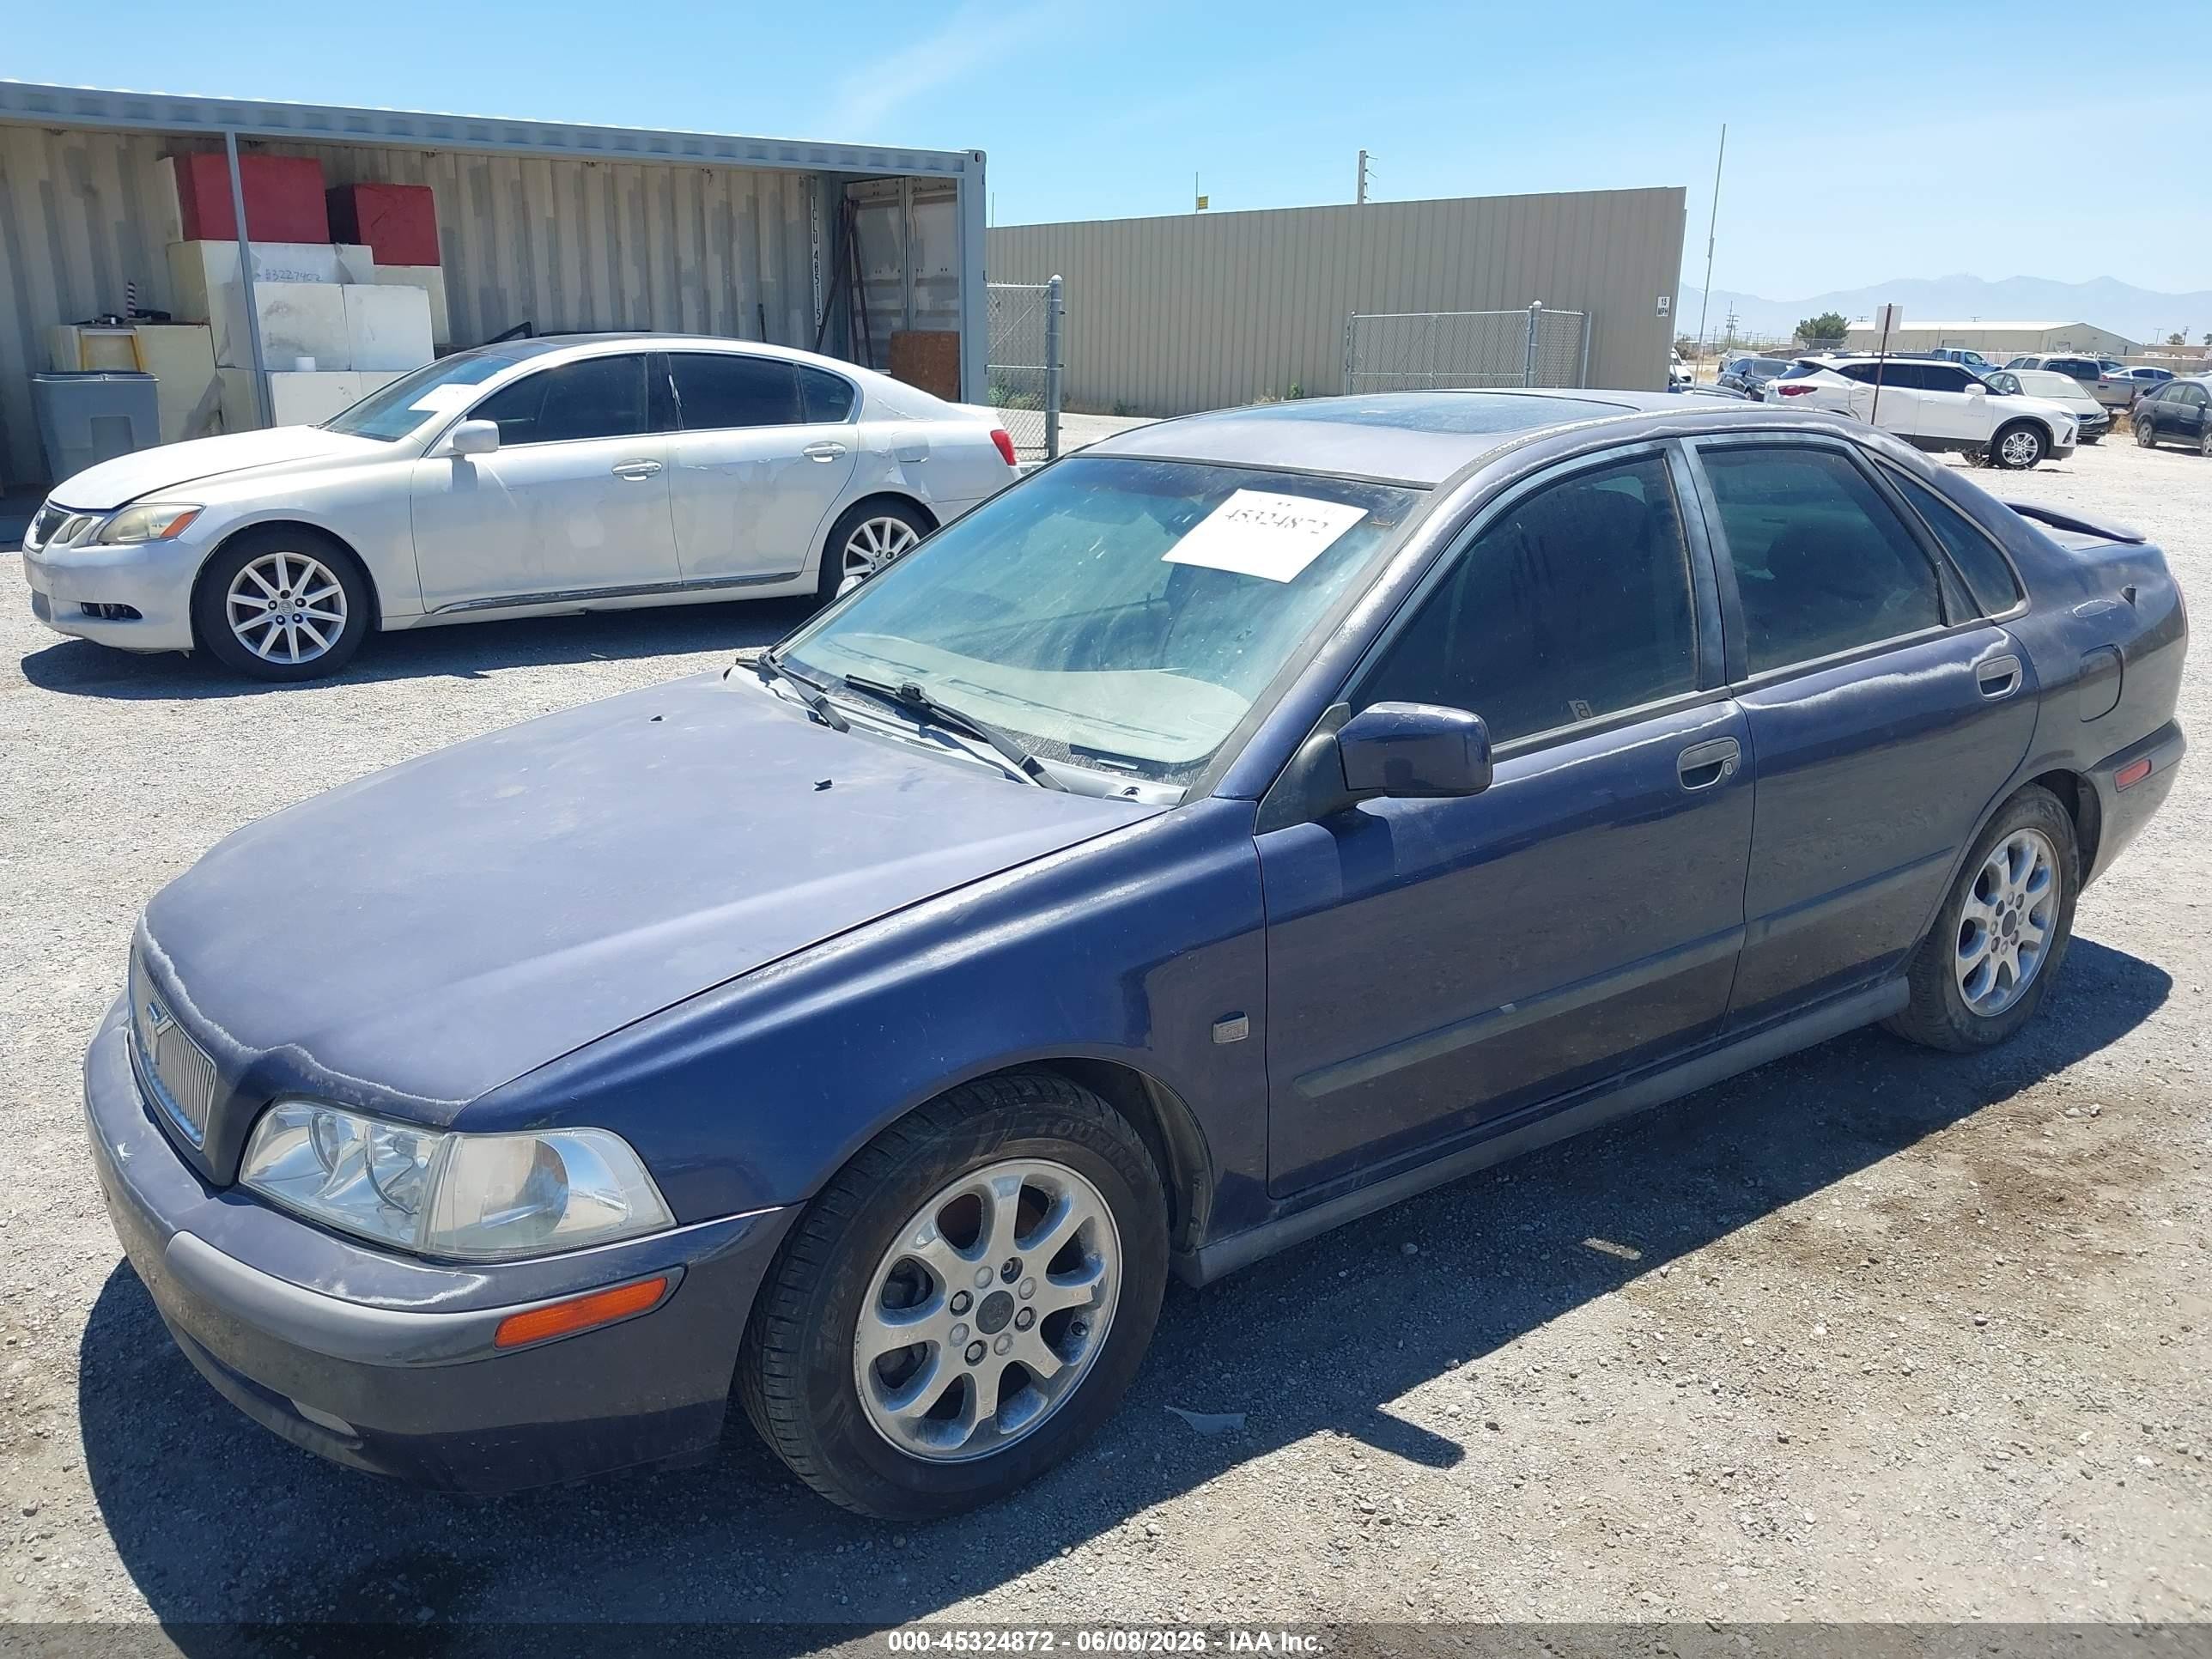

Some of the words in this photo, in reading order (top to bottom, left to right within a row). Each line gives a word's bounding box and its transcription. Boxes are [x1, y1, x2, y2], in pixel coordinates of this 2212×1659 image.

[813, 250, 823, 320] 485115
[1661, 297, 1668, 307] 15
[1657, 307, 1668, 315] MPH
